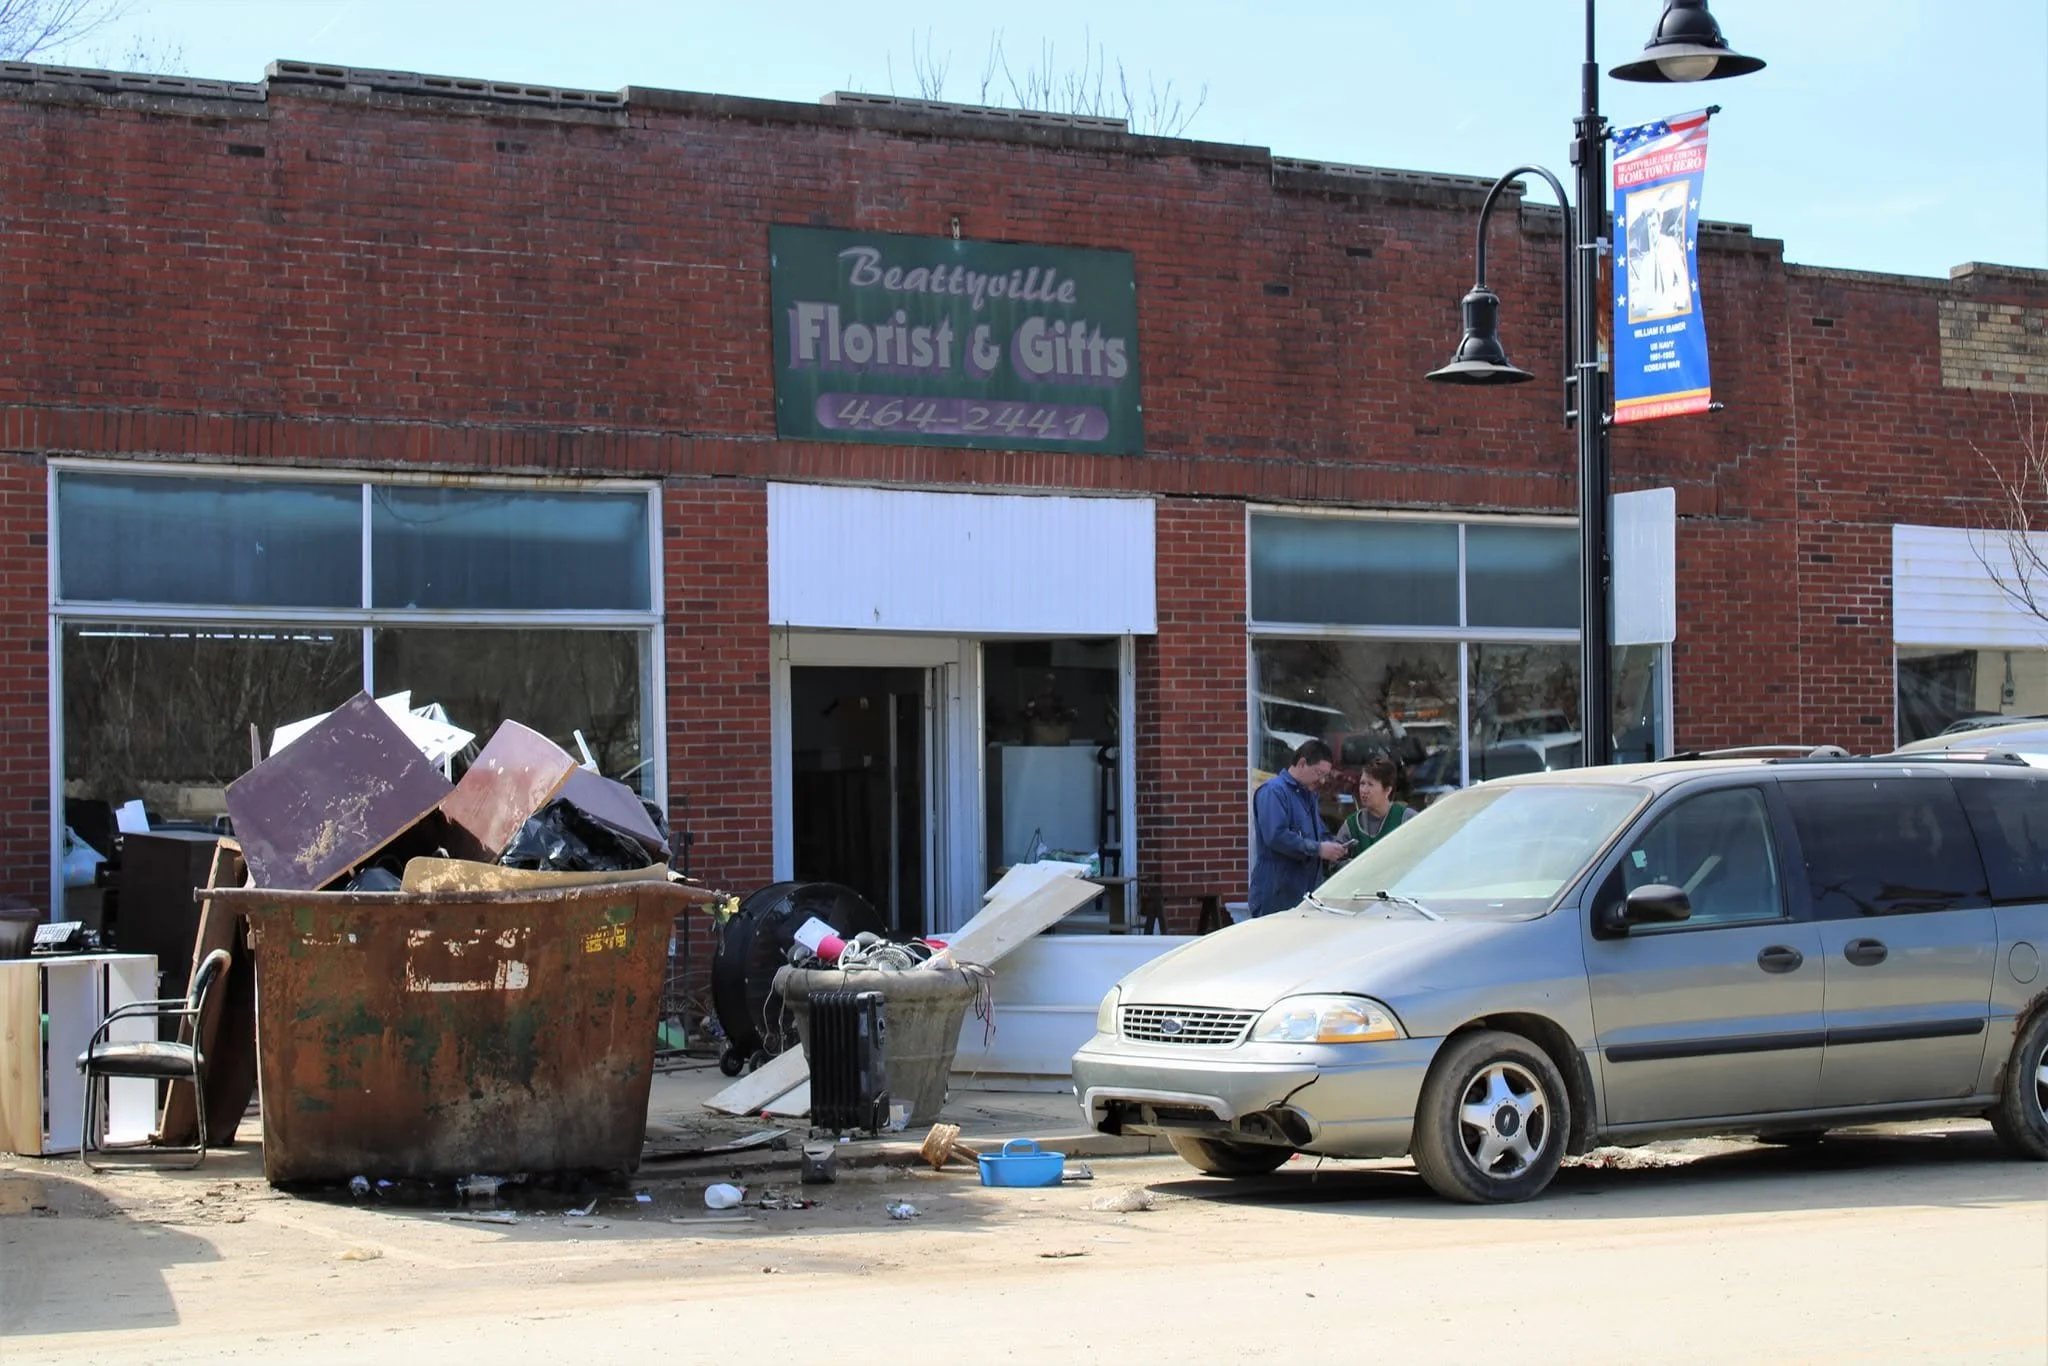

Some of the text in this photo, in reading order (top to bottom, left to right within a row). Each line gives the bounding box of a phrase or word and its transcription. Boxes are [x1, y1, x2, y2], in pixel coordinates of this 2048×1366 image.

[1617, 157, 1702, 185] HOMETOWN HERO
[837, 246, 1077, 310] Beattyville
[788, 300, 1129, 386] Florist & Gifts
[1658, 340, 1674, 350] NAVY
[1667, 360, 1680, 369] WAR
[837, 398, 1088, 435] 464-2441
